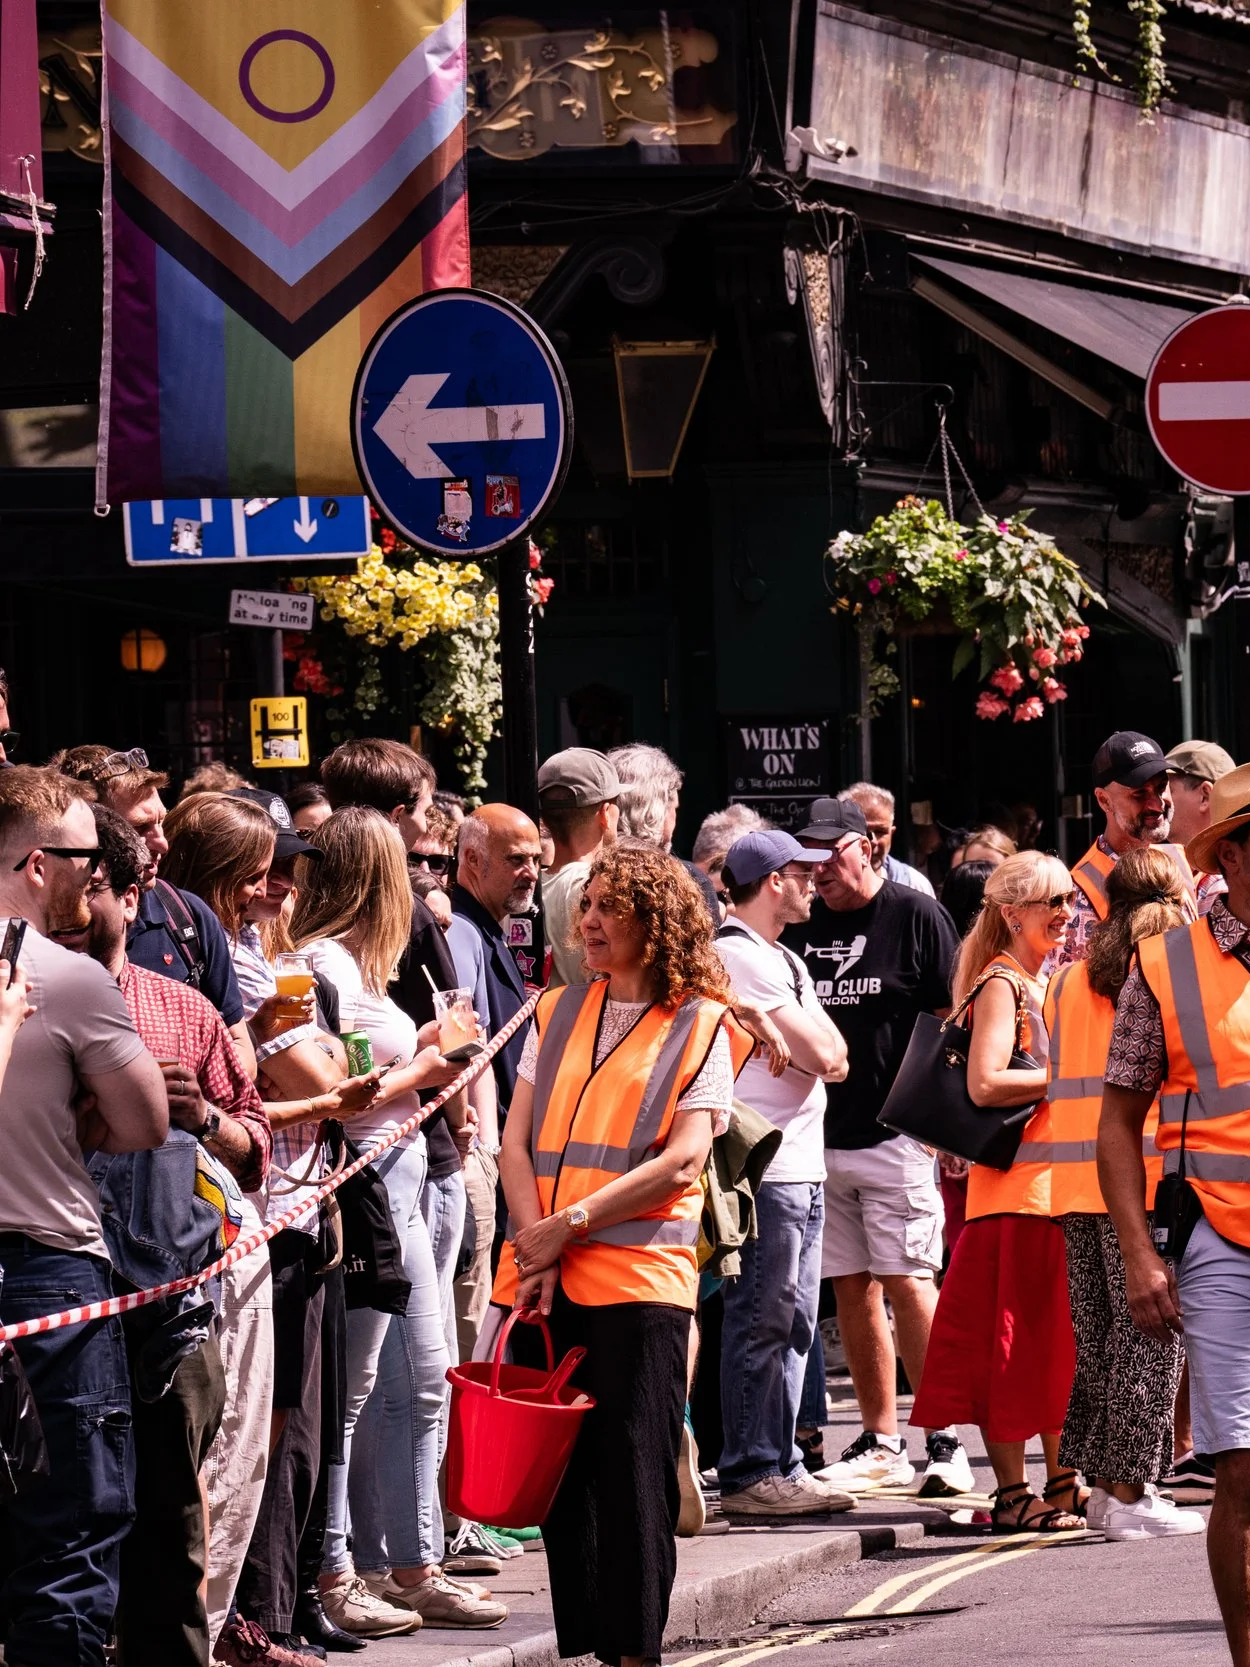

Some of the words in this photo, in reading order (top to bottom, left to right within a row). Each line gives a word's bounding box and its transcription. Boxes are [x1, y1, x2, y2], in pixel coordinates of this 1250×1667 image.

[260, 596, 307, 612] loang
[234, 609, 248, 619] at
[279, 612, 308, 624] time
[272, 712, 289, 721] 100
[740, 723, 820, 751] WHAT'S
[763, 753, 795, 775] ON
[837, 977, 881, 996] CLUB
[818, 996, 860, 1006] NDON
[346, 1041, 369, 1070] IGINAL
